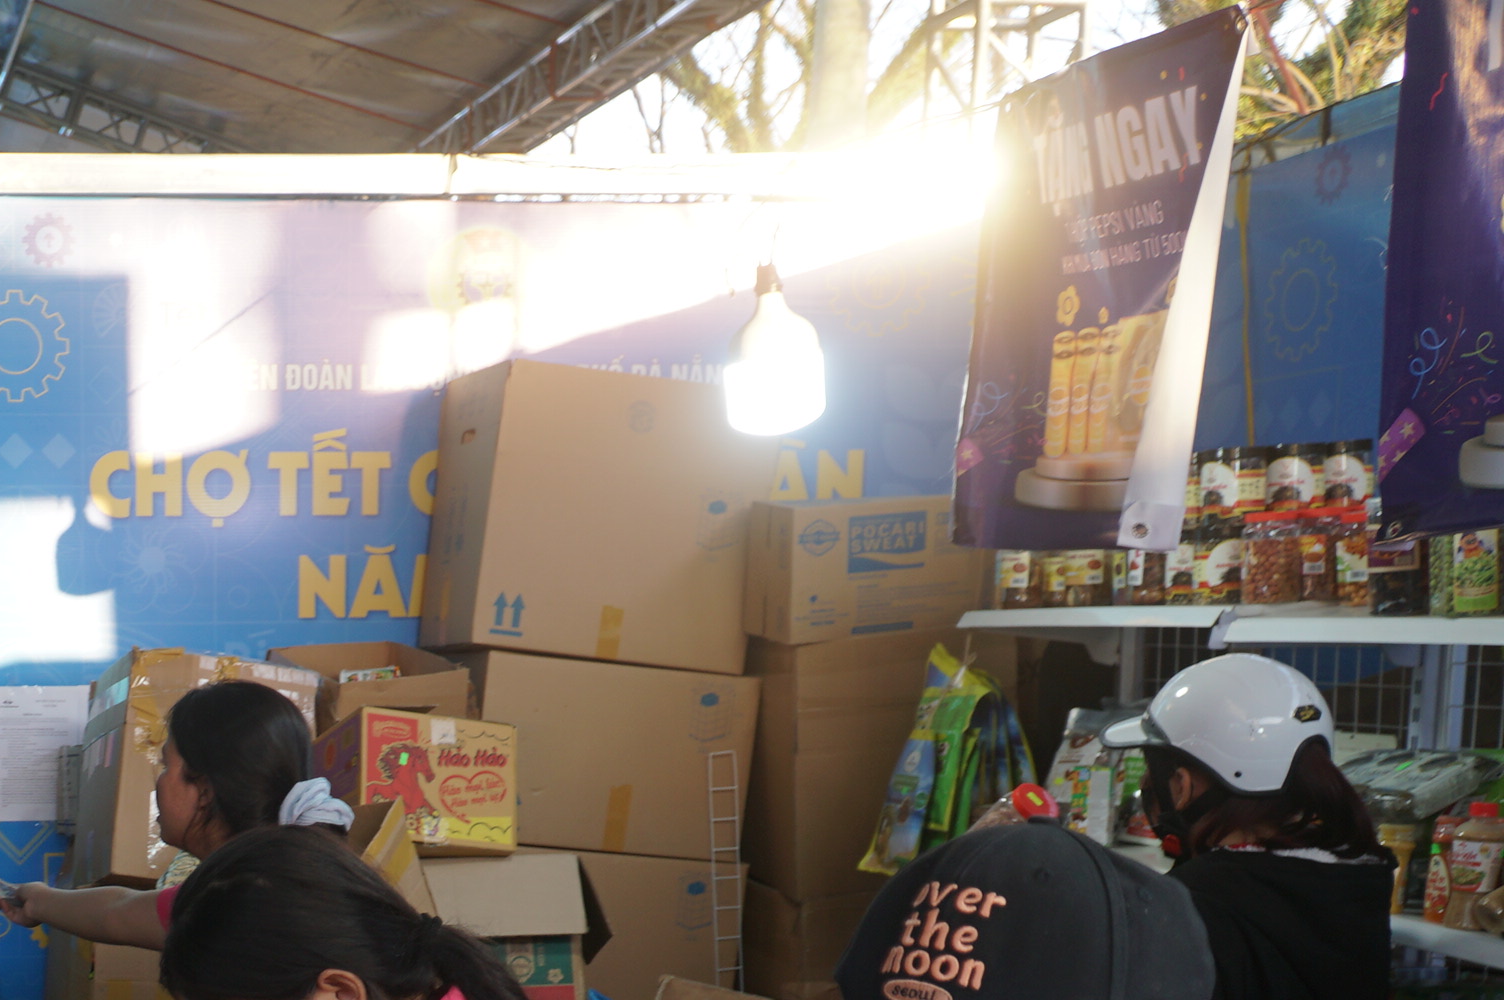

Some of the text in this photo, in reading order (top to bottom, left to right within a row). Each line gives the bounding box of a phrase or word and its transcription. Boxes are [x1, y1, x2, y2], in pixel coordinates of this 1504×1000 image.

[1095, 85, 1201, 189] NGAY
[285, 359, 353, 391] ĐOÀN
[89, 449, 252, 528] CHỢ
[267, 428, 391, 516] TẾT
[769, 438, 866, 500] ÀN
[850, 535, 917, 552] SWEAT
[851, 520, 926, 539] POCARI
[437, 746, 508, 768] Hảo Hảo
[901, 908, 979, 953] the
